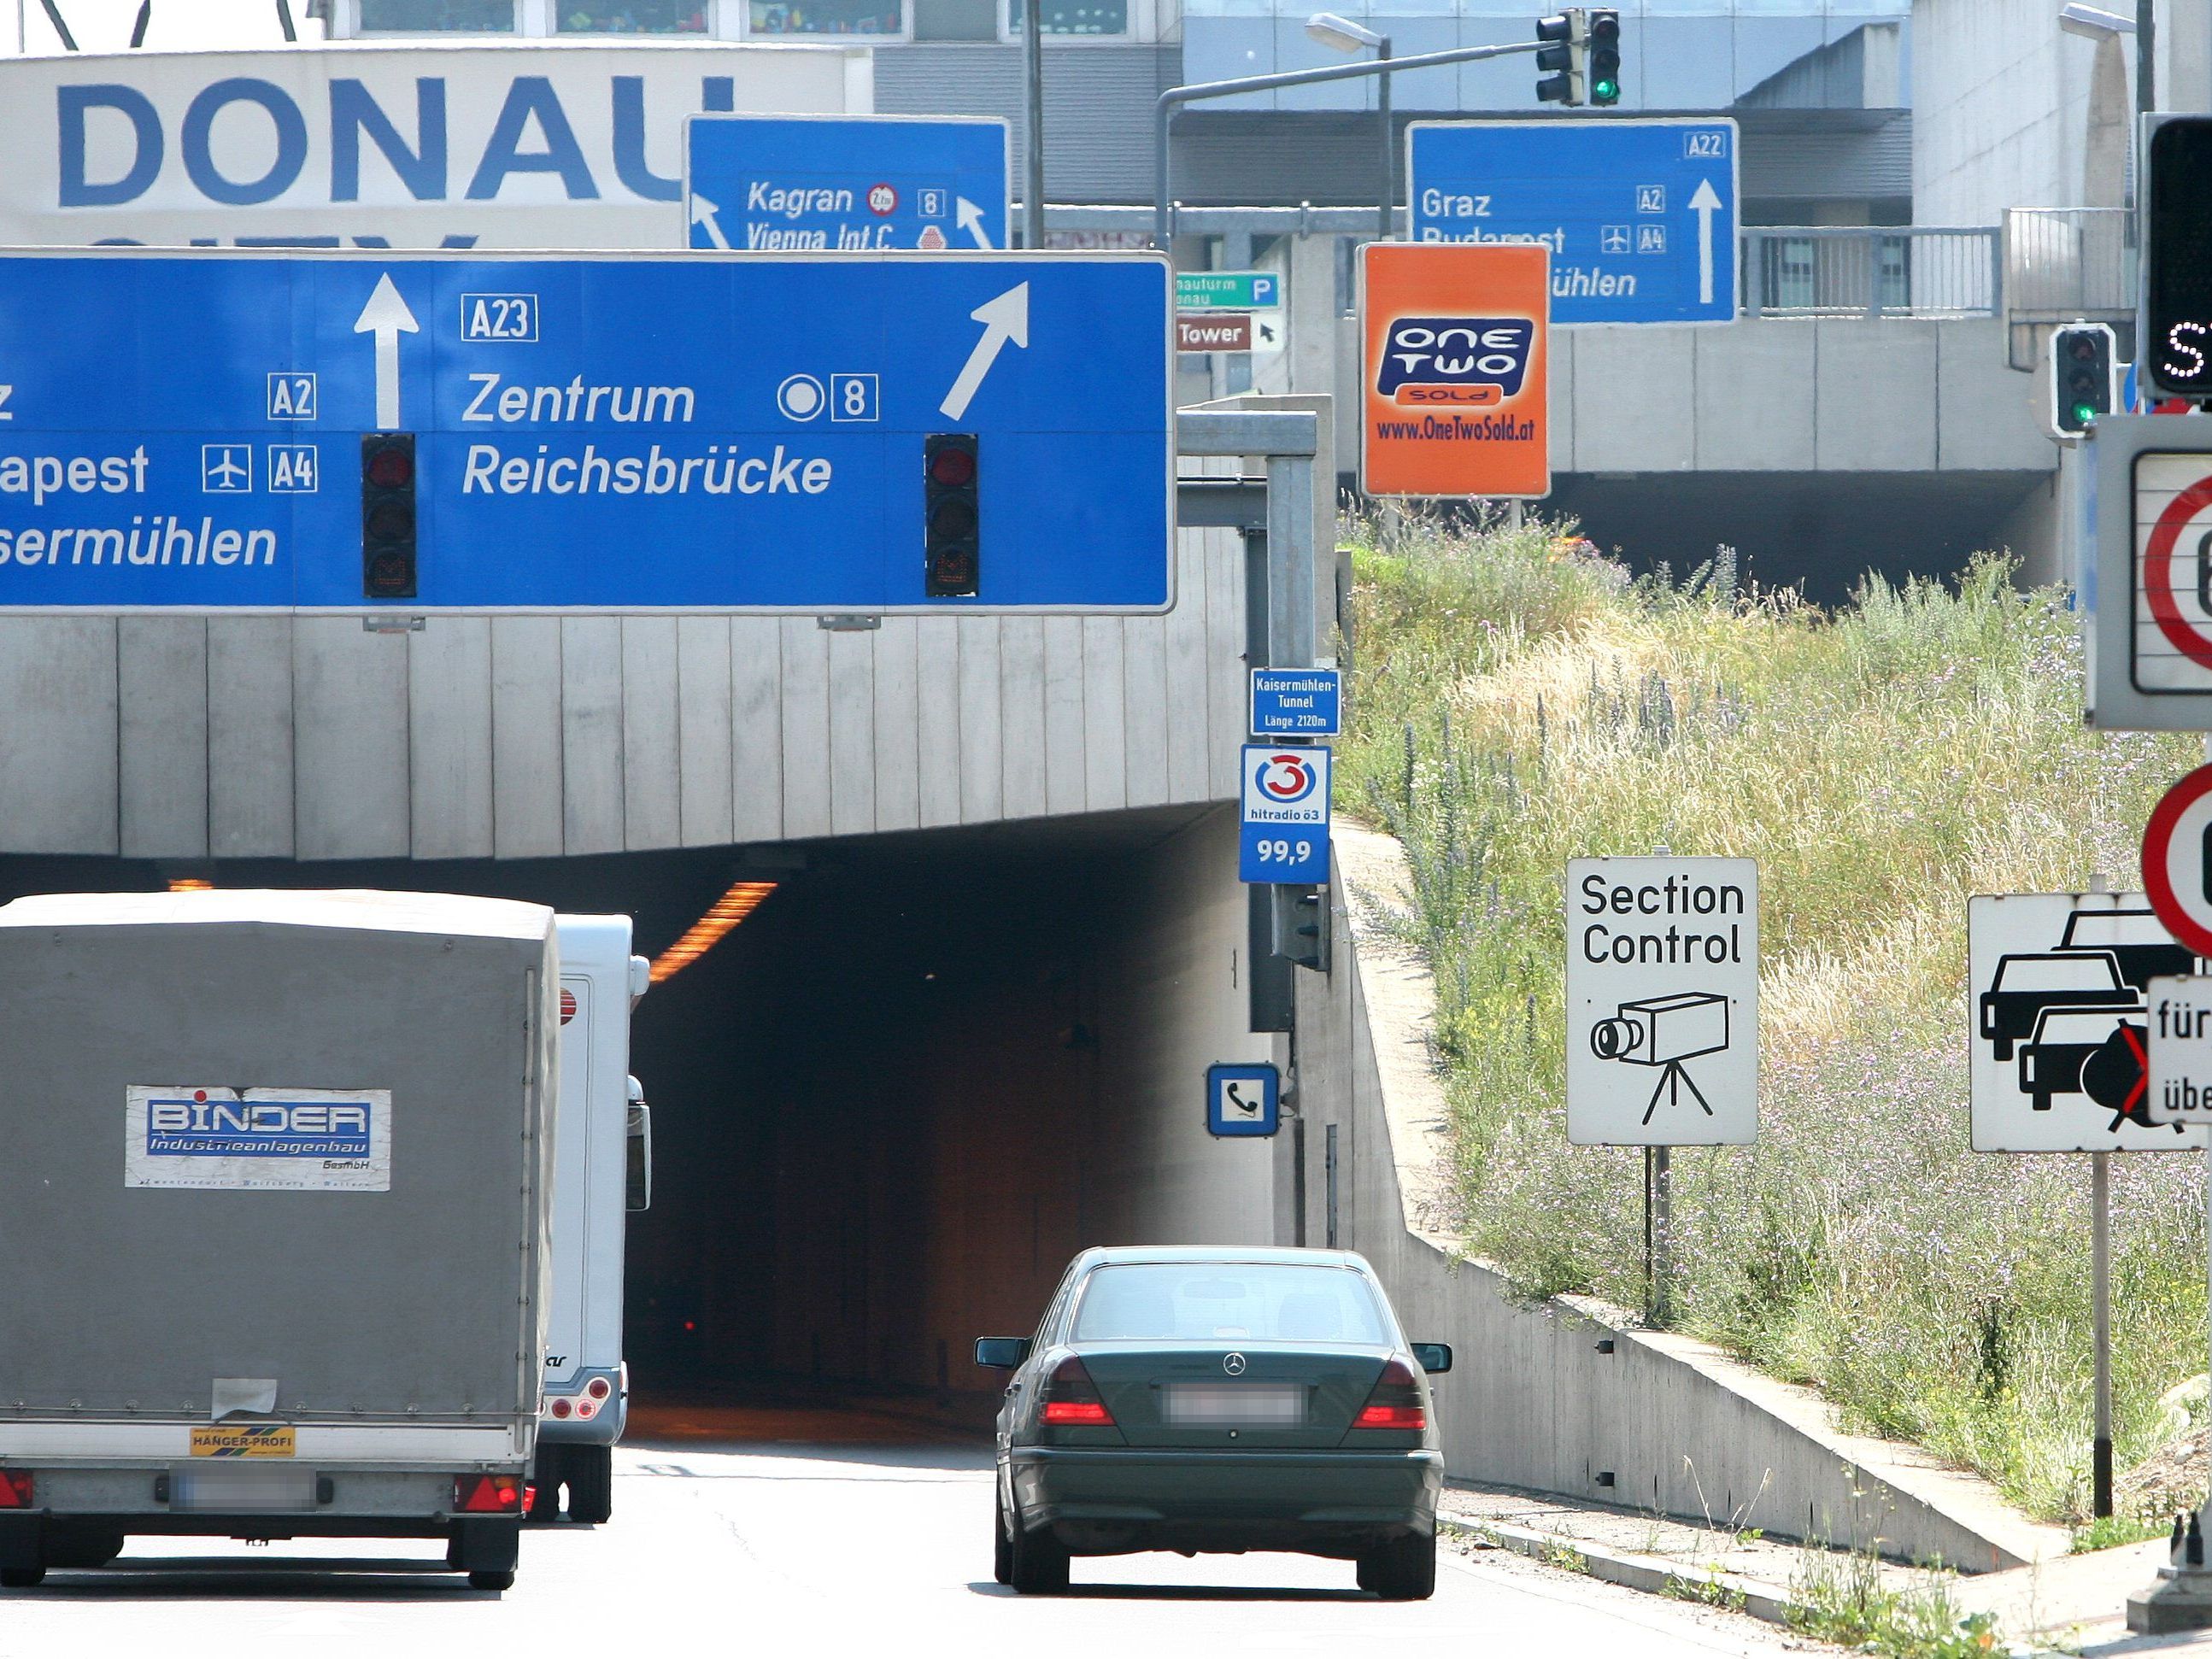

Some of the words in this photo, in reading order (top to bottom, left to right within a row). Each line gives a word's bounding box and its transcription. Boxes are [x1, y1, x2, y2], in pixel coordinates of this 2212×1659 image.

[57, 75, 734, 209] DONAU
[1688, 135, 1722, 155] A22
[748, 182, 853, 220] Kagran
[925, 193, 937, 214] 8
[1423, 188, 1491, 217] Graz
[1640, 190, 1661, 210] A2
[1640, 230, 1663, 249] A4
[470, 299, 530, 338] A23
[1179, 324, 1242, 343] Tower
[2164, 321, 2212, 377] S
[273, 378, 312, 415] A2
[462, 374, 695, 422] Zentrum
[843, 379, 866, 416] 8
[1377, 414, 1534, 441] www.OneTwoSold.at
[0, 444, 150, 506] apest
[273, 451, 313, 487] A4
[463, 444, 833, 495] Reichsbrücke
[1257, 677, 1336, 692] Kaisermühlen-
[1278, 695, 1313, 708] Tunnel
[1265, 715, 1293, 729] Länge
[1297, 715, 1326, 727] 2120m
[1251, 809, 1300, 820] hitradio
[1304, 810, 1319, 820] ö3
[1257, 840, 1311, 865] 99,9
[1581, 874, 1744, 915] Section
[1584, 923, 1741, 964] Control
[2158, 999, 2211, 1039] für
[150, 1138, 366, 1154] Industrieanlagenbau
[194, 1435, 290, 1446] HÄNGER-PROFI
